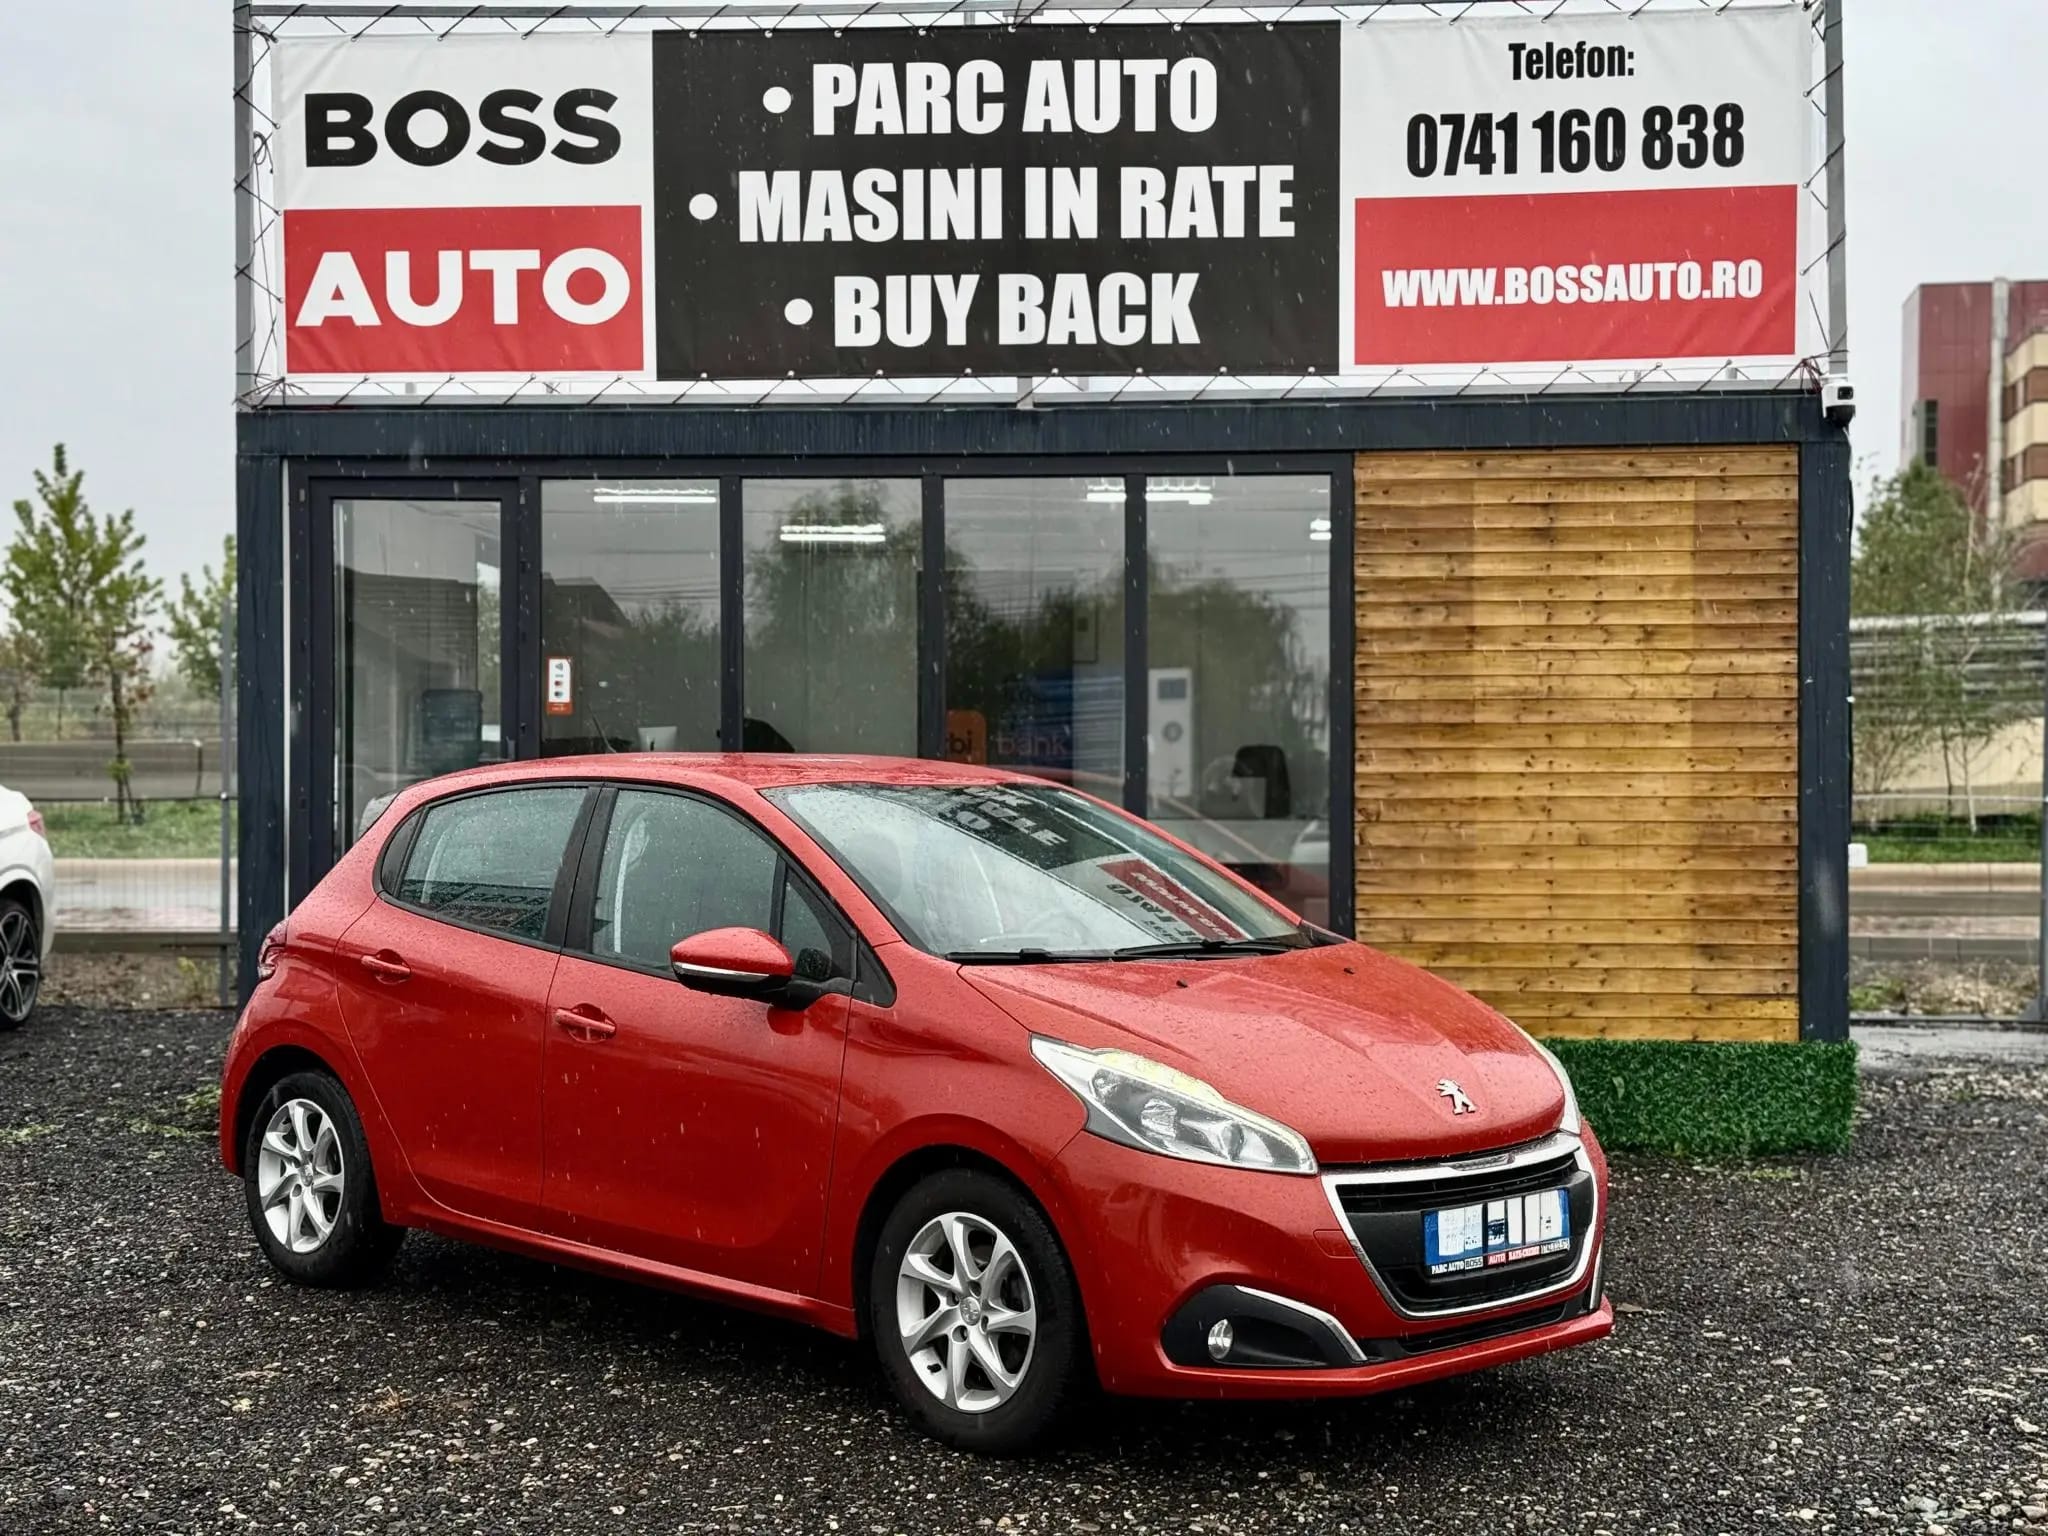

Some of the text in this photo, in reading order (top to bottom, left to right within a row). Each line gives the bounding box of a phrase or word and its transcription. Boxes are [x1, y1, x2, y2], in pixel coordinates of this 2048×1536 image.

[813, 57, 1218, 136] PARC AUTO
[1509, 41, 1634, 81] Telefon:
[304, 89, 621, 168] BOSS
[1407, 103, 1745, 178] 0741 160 838
[739, 165, 1295, 243] MASINI IN RATE
[295, 248, 631, 327] AUTO
[835, 272, 1201, 348] BUY BACK
[1382, 259, 1763, 308] WWW.BOSSAUTO.RO
[996, 728, 1067, 757] bank
[1465, 1257, 1483, 1269] BOSS
